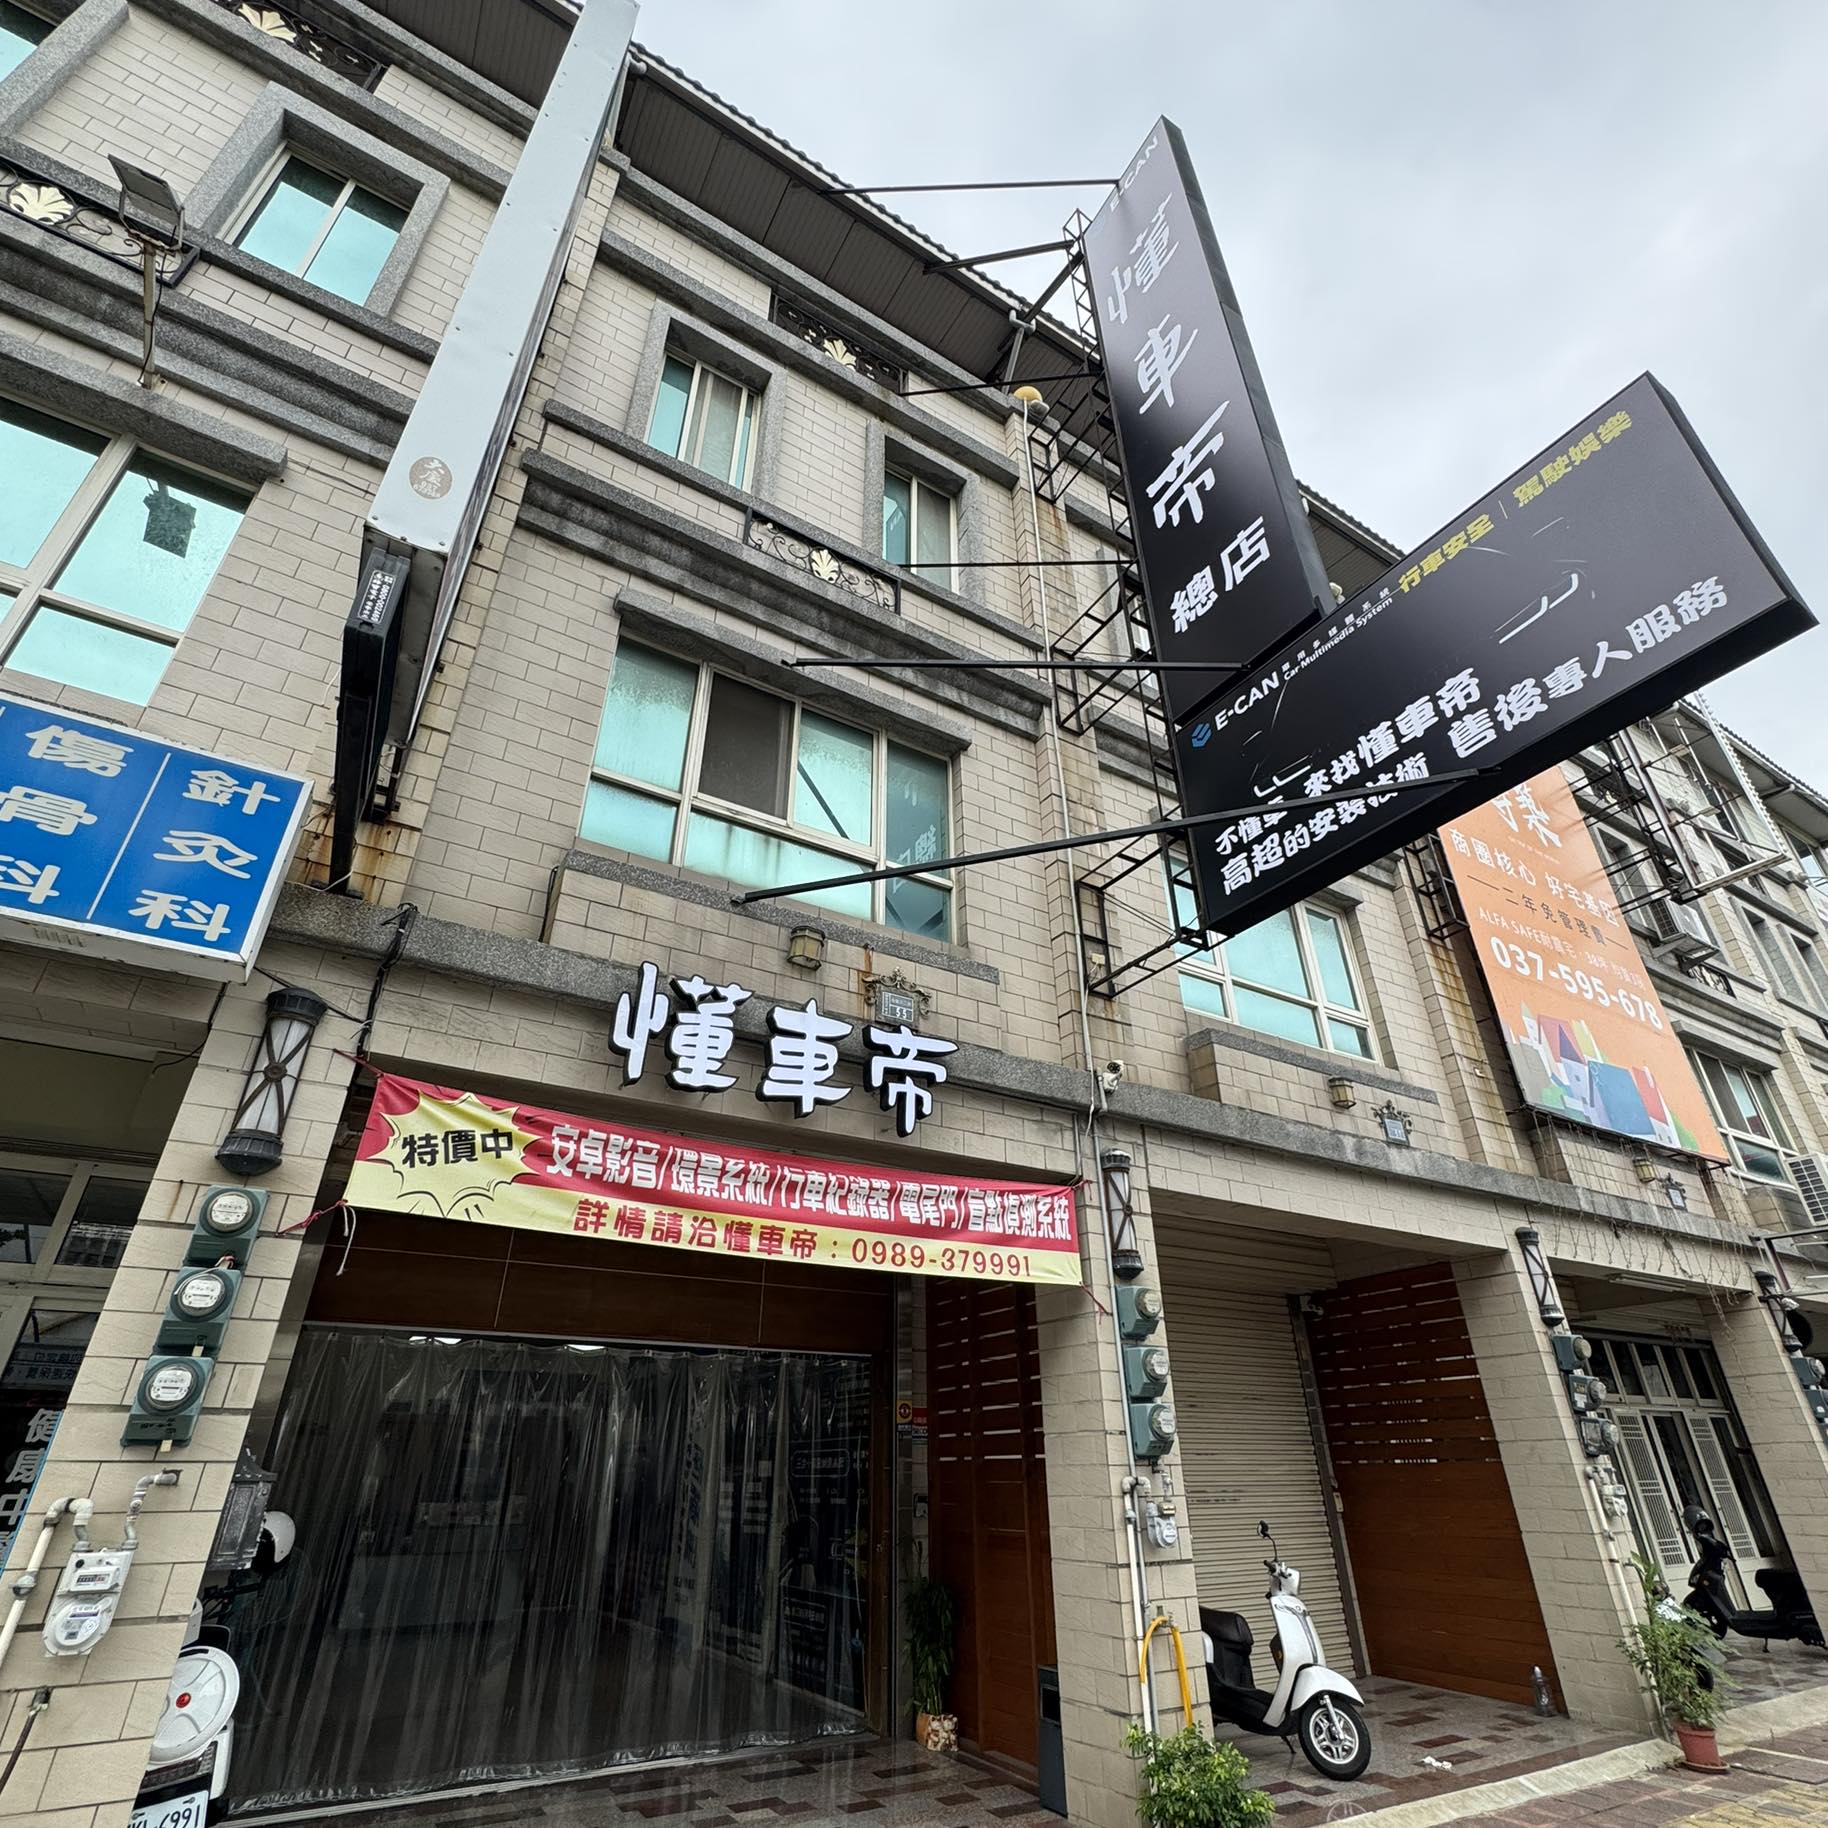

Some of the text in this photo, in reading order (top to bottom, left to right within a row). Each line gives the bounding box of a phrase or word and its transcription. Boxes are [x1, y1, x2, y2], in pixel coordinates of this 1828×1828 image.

[1108, 192, 1230, 528] 懂車帝
[1399, 410, 1632, 593] 行車安全 駕駛娛樂
[1170, 516, 1271, 633] 總店
[1283, 597, 1393, 681] Car Multimedia System
[1448, 576, 1728, 759] 售後專人服務
[1215, 671, 1280, 731] E-CAN
[1304, 667, 1480, 798] 來找懂車帝
[128, 769, 281, 942] 針灸科
[1449, 828, 1536, 887] 商圈核心
[1544, 872, 1620, 928] 好宅基因
[1479, 907, 1510, 930] ALFA
[1490, 936, 1663, 1031] 037-595-678
[609, 961, 959, 1136] 懂車帝
[401, 1128, 514, 1169] 特價中
